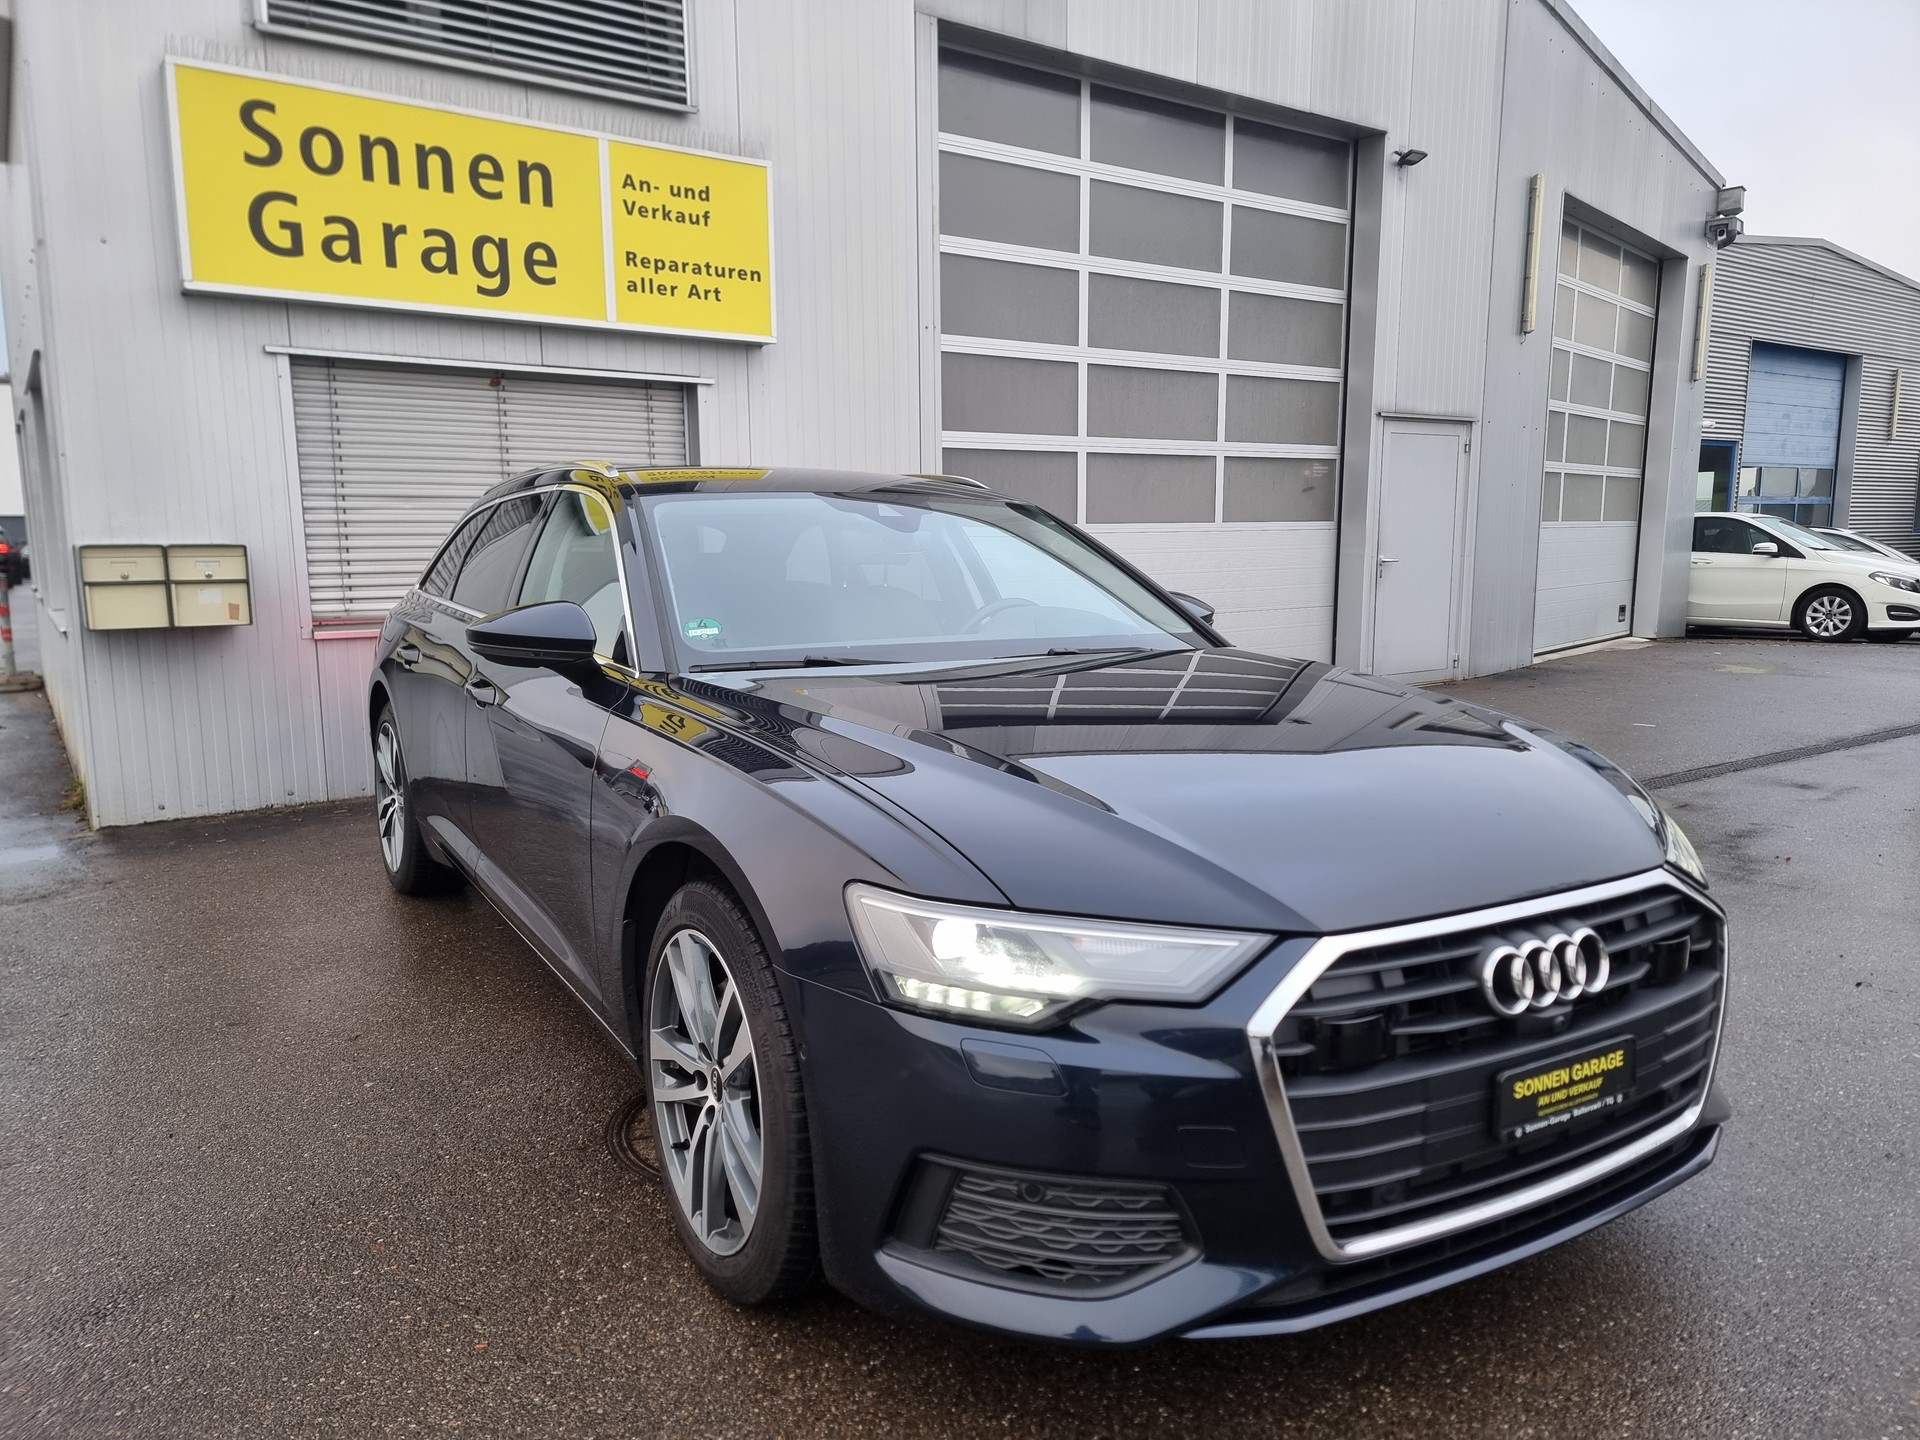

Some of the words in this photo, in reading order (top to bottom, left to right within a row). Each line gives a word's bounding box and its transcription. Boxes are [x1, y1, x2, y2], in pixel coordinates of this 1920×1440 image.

[239, 99, 554, 208] Sonnen
[621, 173, 660, 194] An-
[668, 183, 711, 203] und
[622, 199, 712, 227] Verkauf
[247, 190, 558, 298] Garage
[625, 250, 763, 283] Reparaturen
[626, 276, 679, 299] aller
[687, 284, 723, 303] Art
[1513, 1068, 1570, 1099] SONNEN
[1571, 1050, 1625, 1081] GARAGE
[1538, 1093, 1550, 1107] AN
[1551, 1088, 1568, 1104] UND
[1568, 1077, 1604, 1096] VERKAUF
